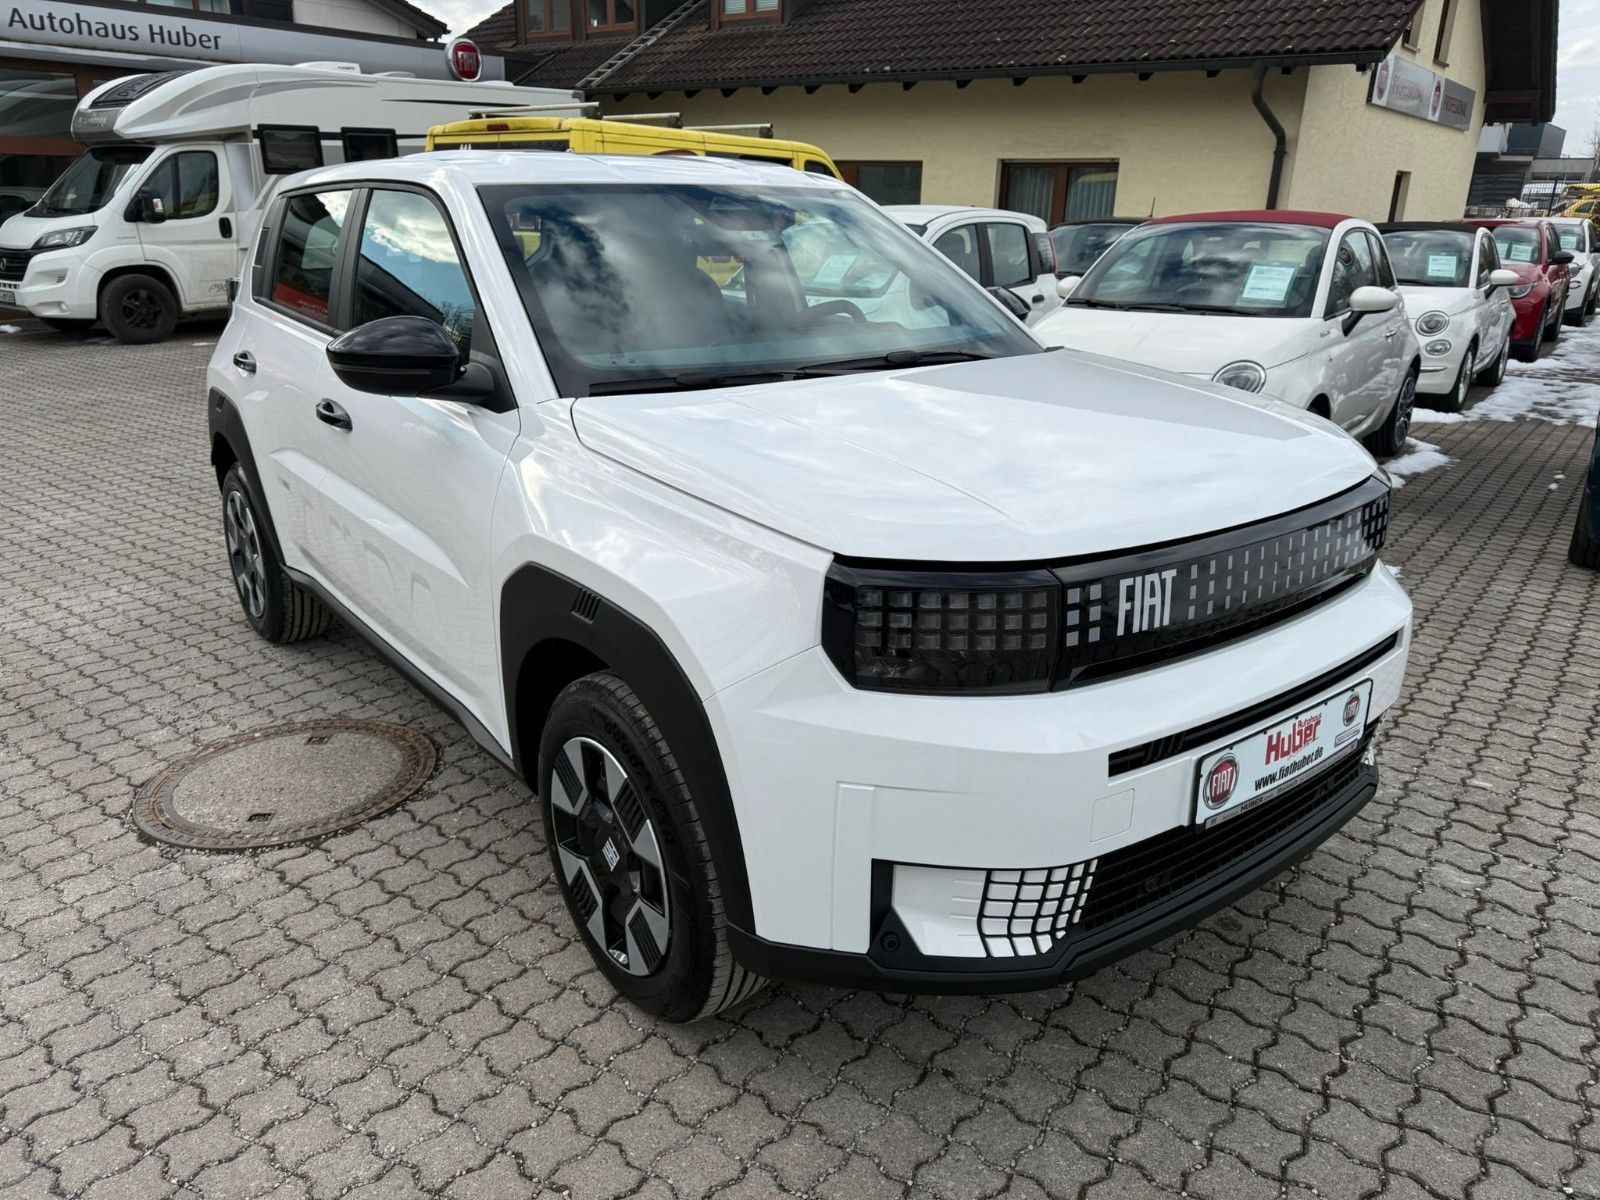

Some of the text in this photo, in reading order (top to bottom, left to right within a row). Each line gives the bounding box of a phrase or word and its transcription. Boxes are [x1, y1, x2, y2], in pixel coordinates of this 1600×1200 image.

[8, 7, 221, 50] Autohaus Huber
[1116, 568, 1177, 636] FIAT
[1265, 719, 1321, 766] Huber
[1212, 767, 1233, 797] FIAT
[1254, 746, 1324, 791] www.fiathuber.de
